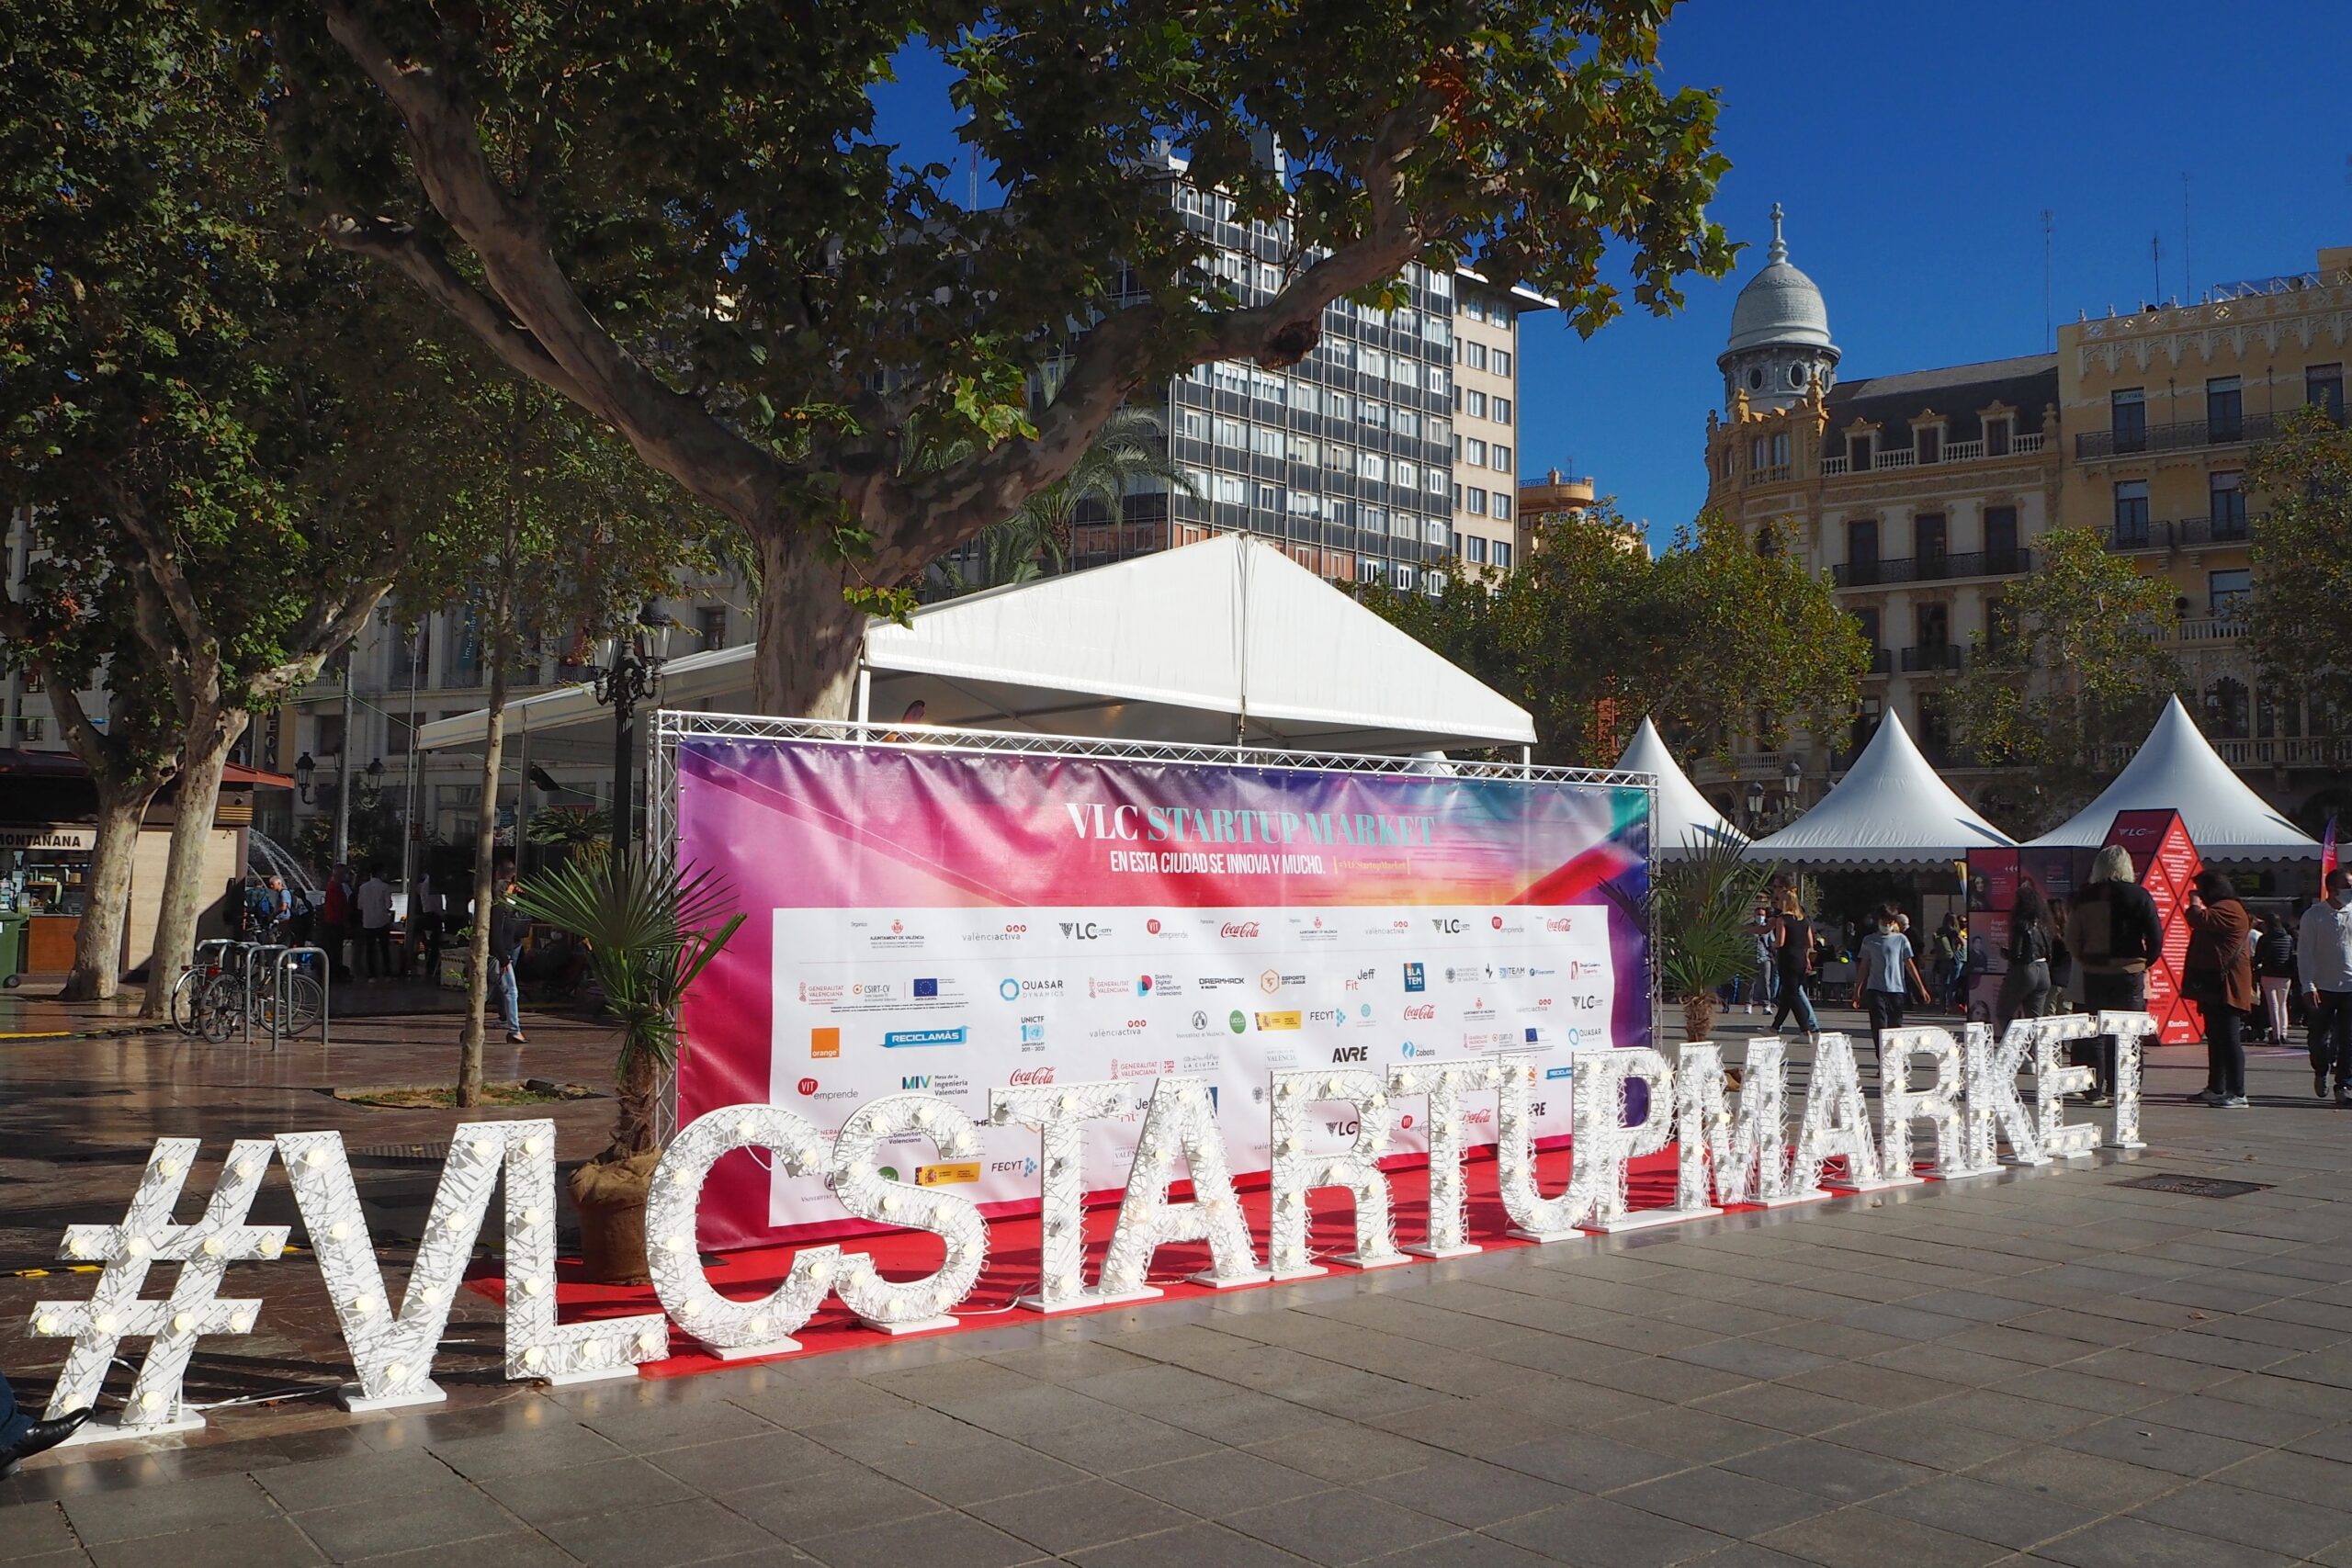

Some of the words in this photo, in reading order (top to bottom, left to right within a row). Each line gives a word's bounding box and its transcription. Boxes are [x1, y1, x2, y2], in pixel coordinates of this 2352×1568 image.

[1066, 803, 1138, 840] VLC
[1148, 807, 1299, 844] STARTUP
[1305, 812, 1435, 847] MARKET
[1110, 851, 1128, 872] EN
[1129, 852, 1158, 873] ESTA
[1160, 852, 1208, 874] CIUDAD
[1209, 852, 1224, 874] SE
[1227, 853, 1271, 874] INNOVA
[1272, 854, 1282, 874] Y
[1282, 854, 1326, 874] MUCHO.
[1148, 921, 1159, 931] VIT
[1221, 921, 1260, 938] Coca-Cola
[963, 933, 1021, 942] valènciactiva
[1357, 968, 1375, 980] Jeff
[1407, 968, 1422, 976] BLA
[1022, 980, 1064, 990] QUASAR
[1345, 980, 1359, 991] Fit
[1408, 976, 1422, 985] TEM
[865, 984, 890, 994] CSIRT-CV
[1310, 1011, 1334, 1021] FECYT
[1404, 1004, 1435, 1021] Coca-Cola
[1021, 1015, 1045, 1023] UNICTF
[892, 1030, 959, 1043] RECICLAMÁS
[1090, 1029, 1141, 1038] valènciactiva
[1579, 1028, 1601, 1037] QUASAR
[812, 1049, 837, 1057] orange
[1332, 1045, 1368, 1063] AVRE
[1416, 1049, 1435, 1057] Cobots
[1011, 1066, 1056, 1086] Coca-Cola
[1121, 1068, 1157, 1077] VALENCIANA
[801, 1081, 815, 1092] VIT
[901, 1075, 933, 1089] MIV
[814, 1089, 859, 1101] emprende
[991, 1160, 1023, 1172] FECYT
